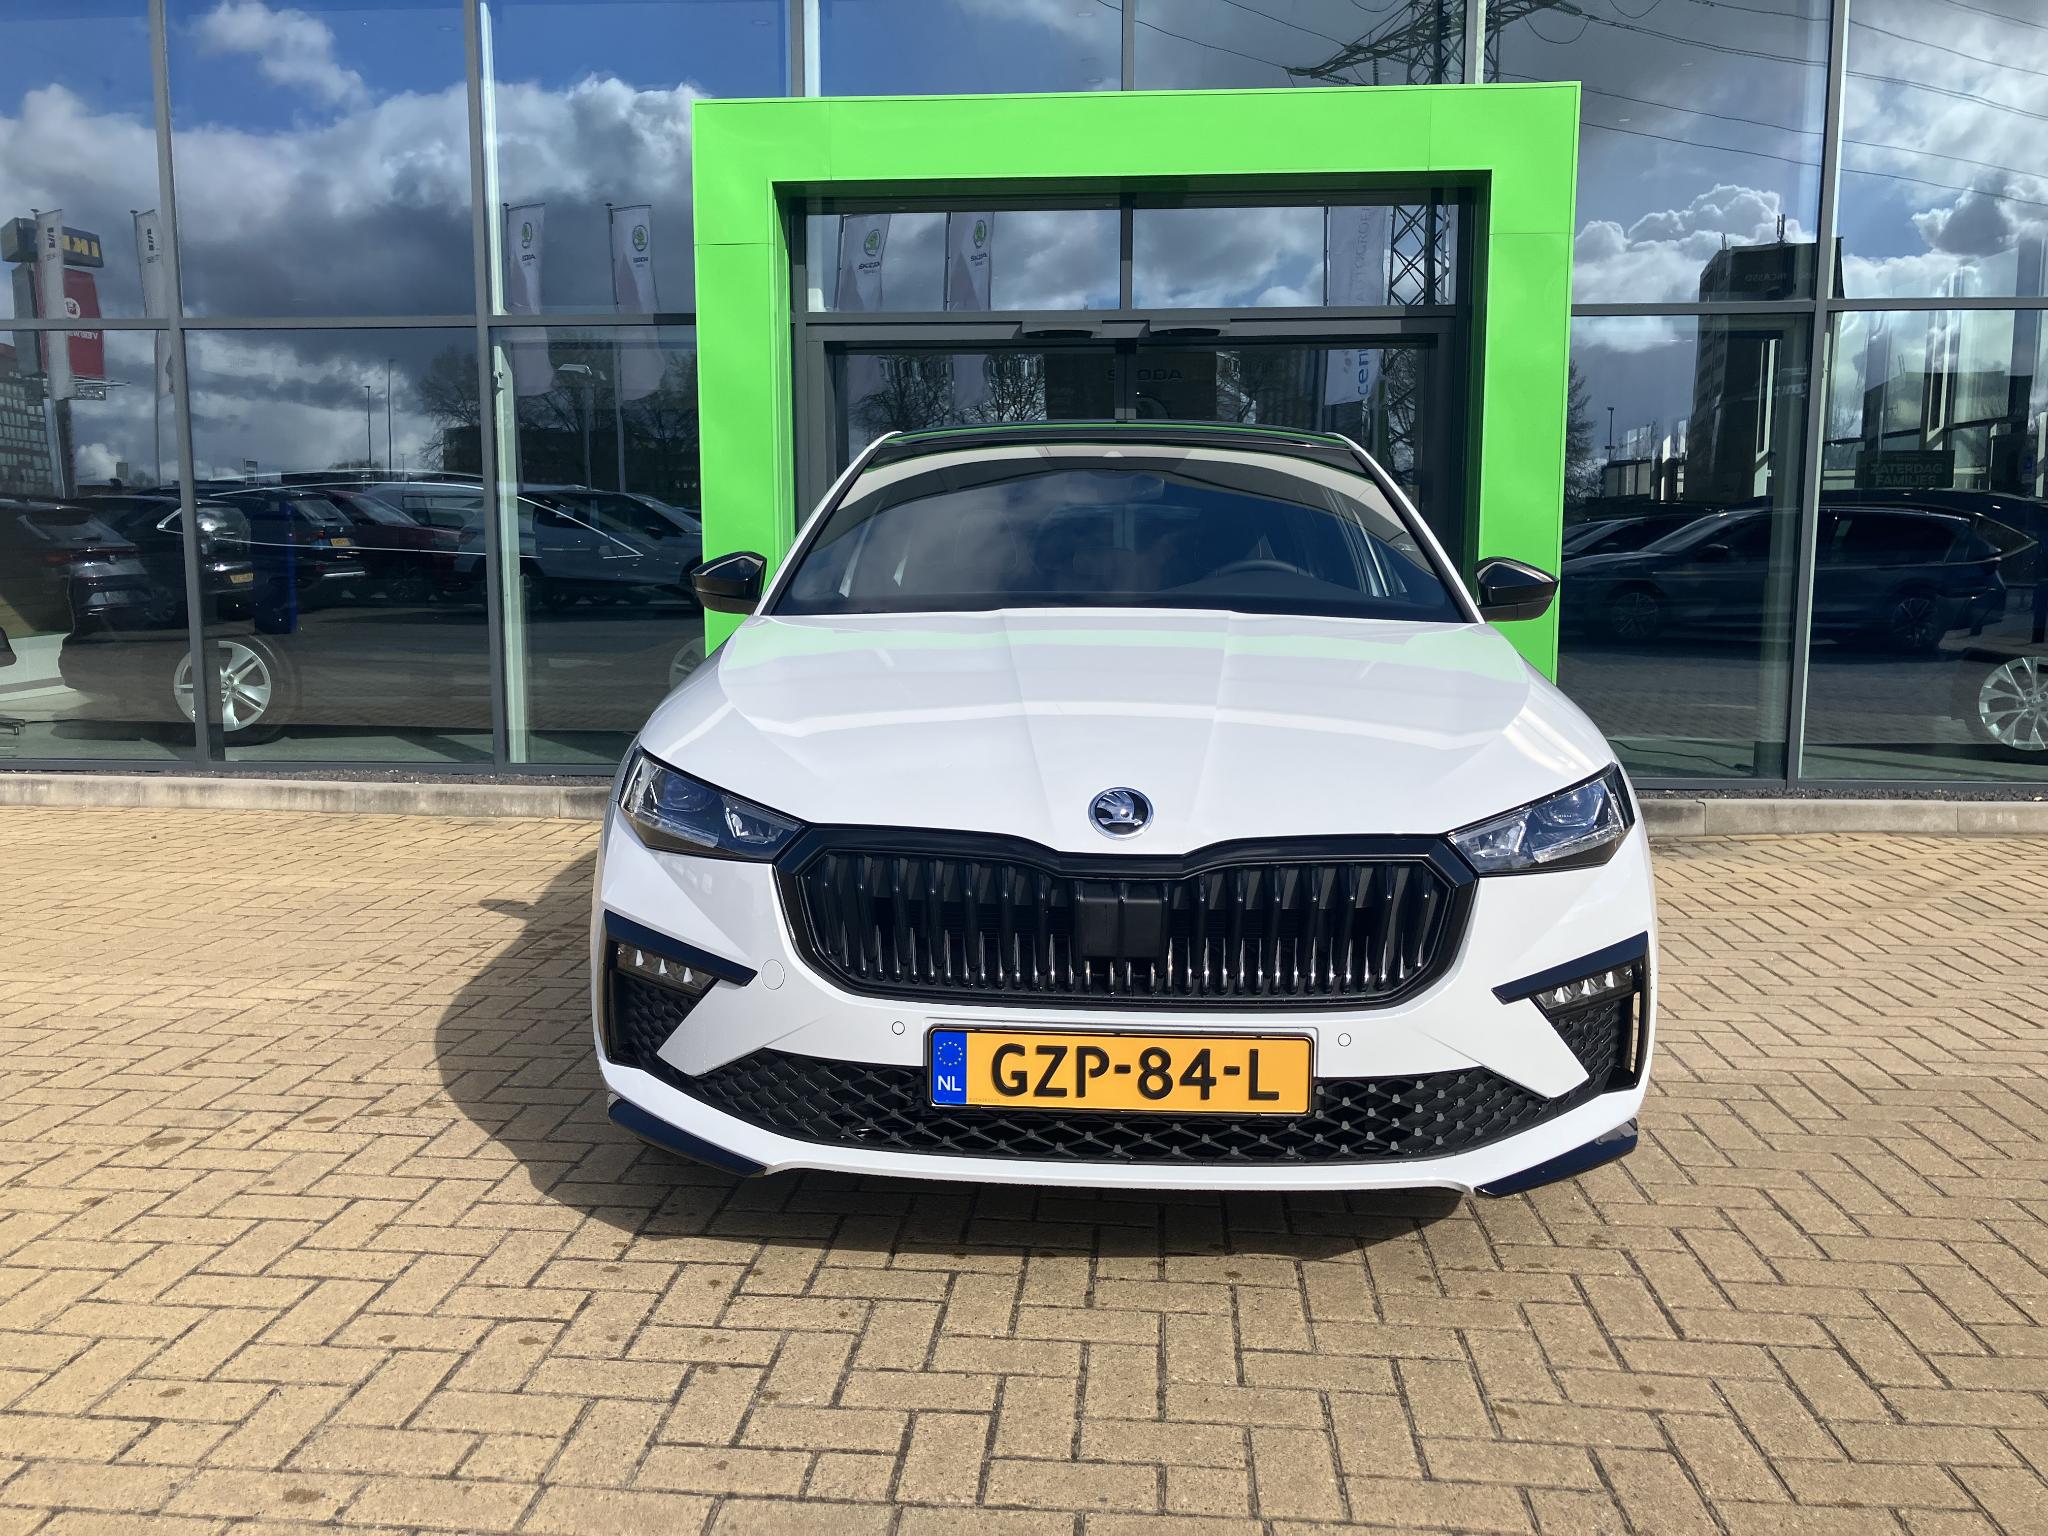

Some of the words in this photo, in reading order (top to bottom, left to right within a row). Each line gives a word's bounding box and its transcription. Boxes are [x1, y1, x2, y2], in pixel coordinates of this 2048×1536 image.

[1357, 349, 1369, 395] cen
[1870, 463, 1943, 474] ZATERDAG
[937, 1075, 962, 1091] NL
[991, 1043, 1280, 1101] GZP-84-L
